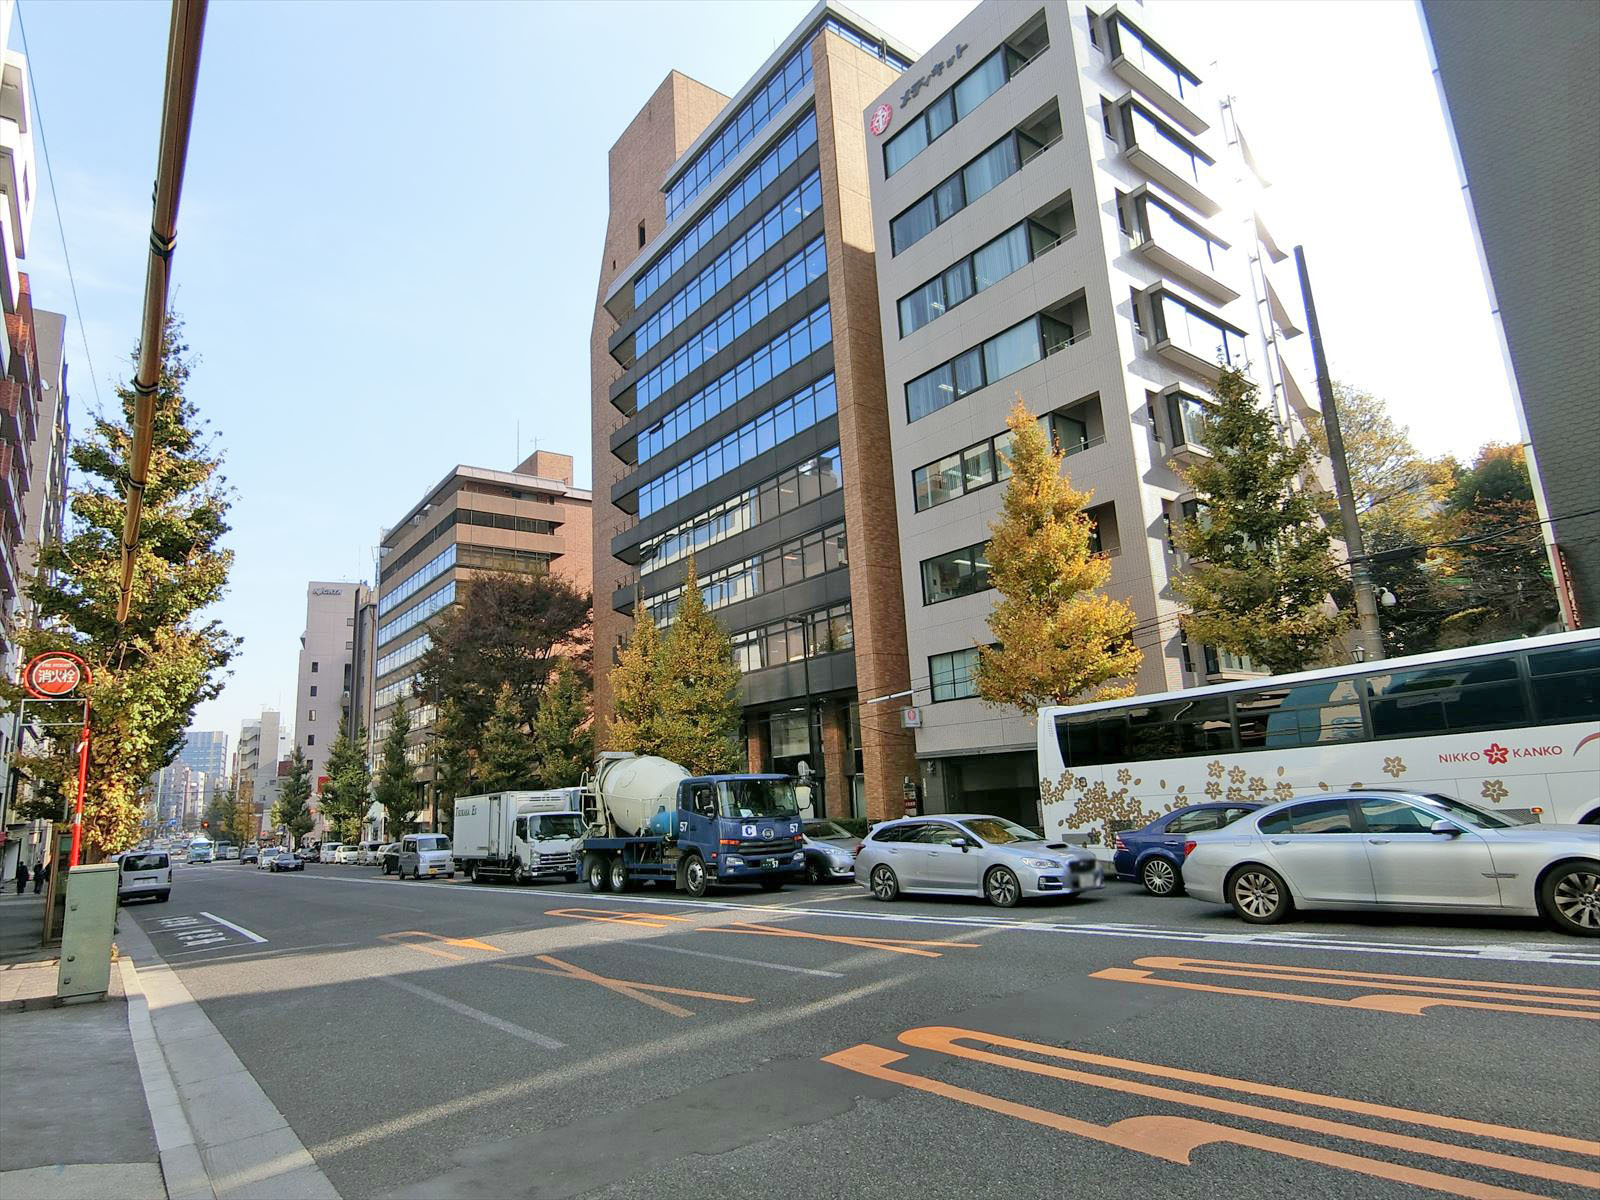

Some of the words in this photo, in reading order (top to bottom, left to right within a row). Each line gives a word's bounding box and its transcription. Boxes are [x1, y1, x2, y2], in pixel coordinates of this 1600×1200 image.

[900, 43, 969, 109] メディキット
[38, 669, 76, 683] 消火栓
[1438, 751, 1481, 763] NIKKO
[1512, 745, 1563, 758] KANKO
[679, 821, 688, 832] 57
[789, 823, 799, 833] 57
